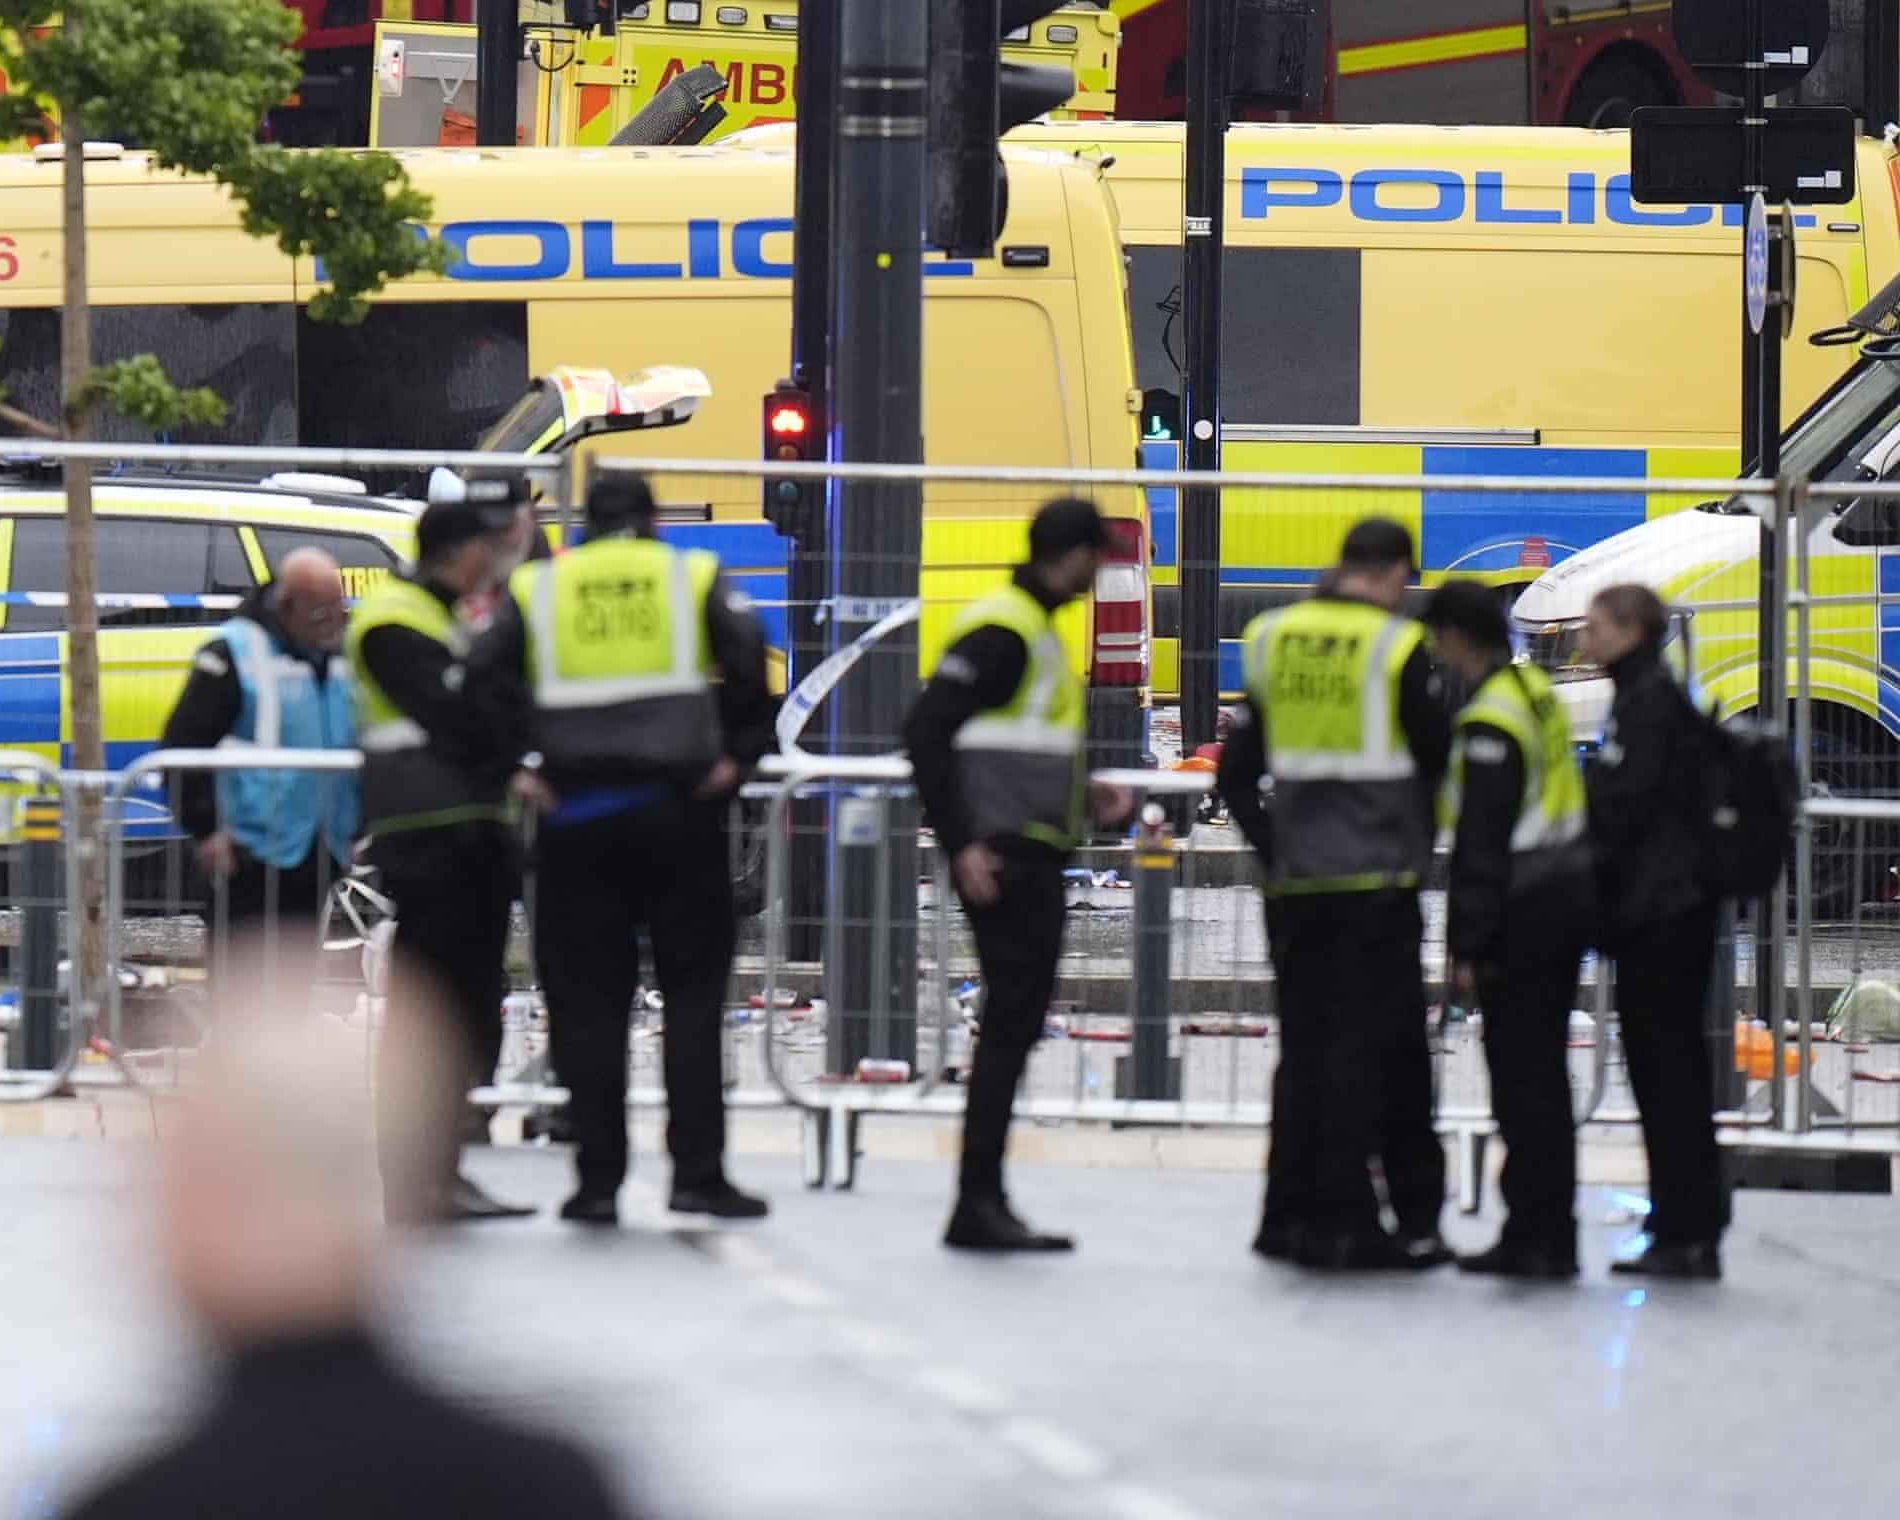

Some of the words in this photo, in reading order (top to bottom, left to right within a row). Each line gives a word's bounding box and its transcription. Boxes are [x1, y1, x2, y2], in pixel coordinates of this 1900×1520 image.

[655, 58, 799, 105] AMB
[1241, 167, 1816, 227] POLIC
[316, 218, 973, 280] OLIC
